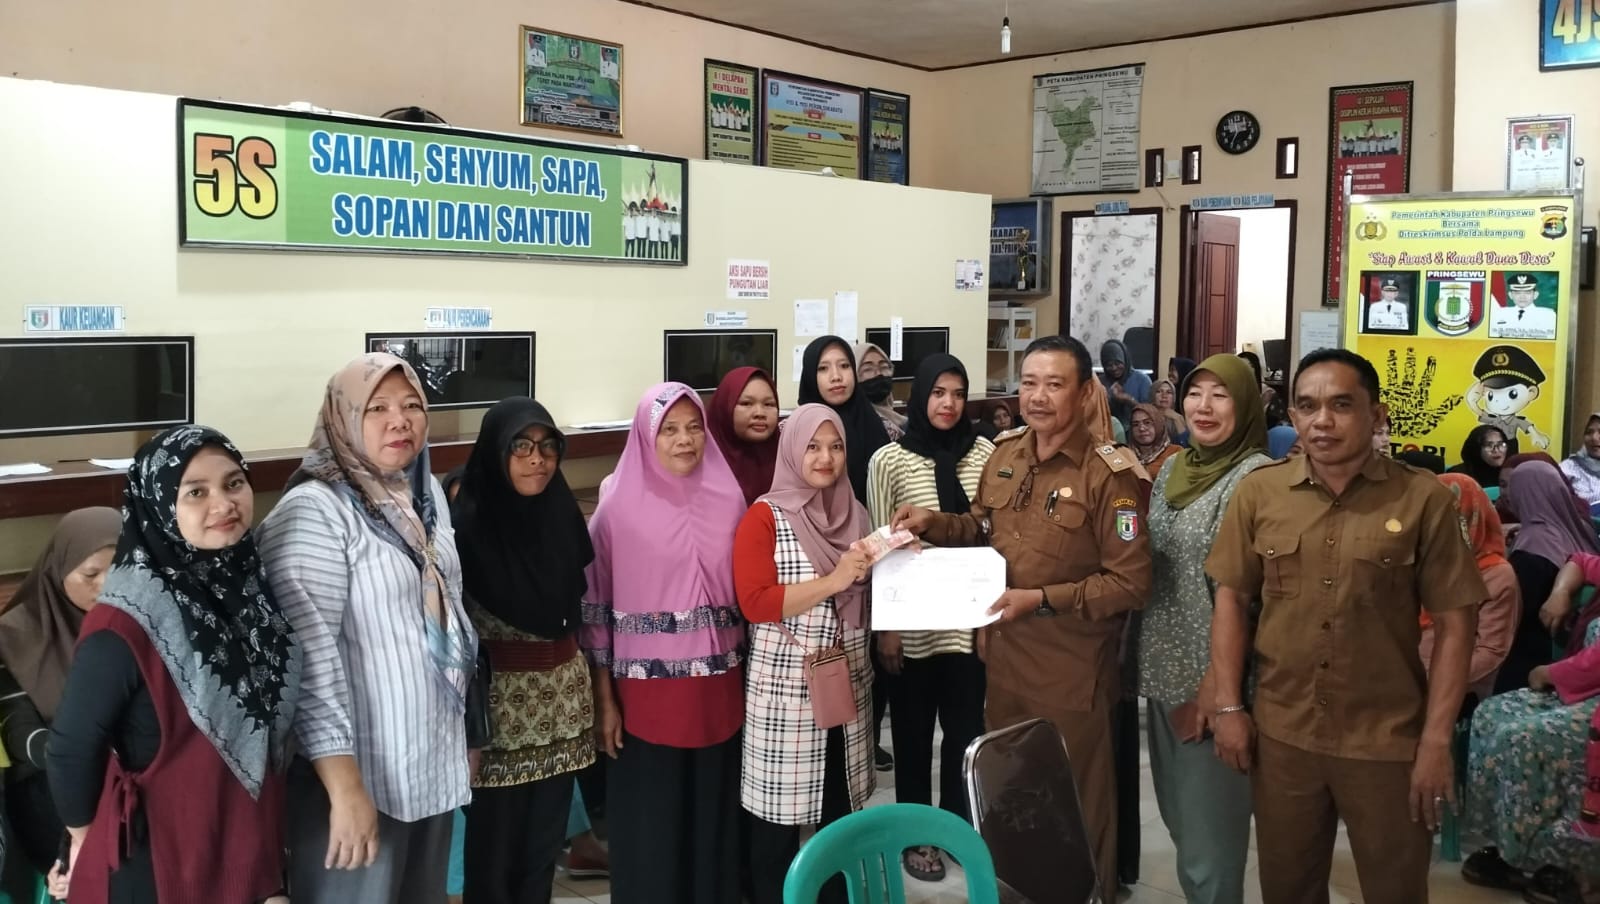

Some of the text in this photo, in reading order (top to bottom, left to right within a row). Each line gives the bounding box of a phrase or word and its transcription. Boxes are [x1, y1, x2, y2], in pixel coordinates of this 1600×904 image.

[310, 131, 607, 201] SALAM, SENYUM, SAPA,
[193, 132, 279, 219] 5S
[1392, 210, 1438, 219] Pemerintah
[1441, 209, 1486, 219] Kabupaten
[1488, 208, 1535, 219] Pringsewu
[333, 194, 592, 247] SOPAN DAN SANTUN
[1442, 220, 1480, 228] Bersama
[1398, 230, 1456, 238] Ditreskrimsus
[1484, 230, 1525, 239] Lampung
[1398, 251, 1432, 265] Awasi
[1434, 251, 1443, 265] &
[1446, 251, 1483, 265] Kawal
[1485, 251, 1517, 265] Dana
[729, 264, 739, 277] AKSI
[740, 265, 752, 277] SAPU
[729, 279, 768, 289] PUNGUTAN LIAR
[60, 306, 115, 330] KAUR KEUANGAN
